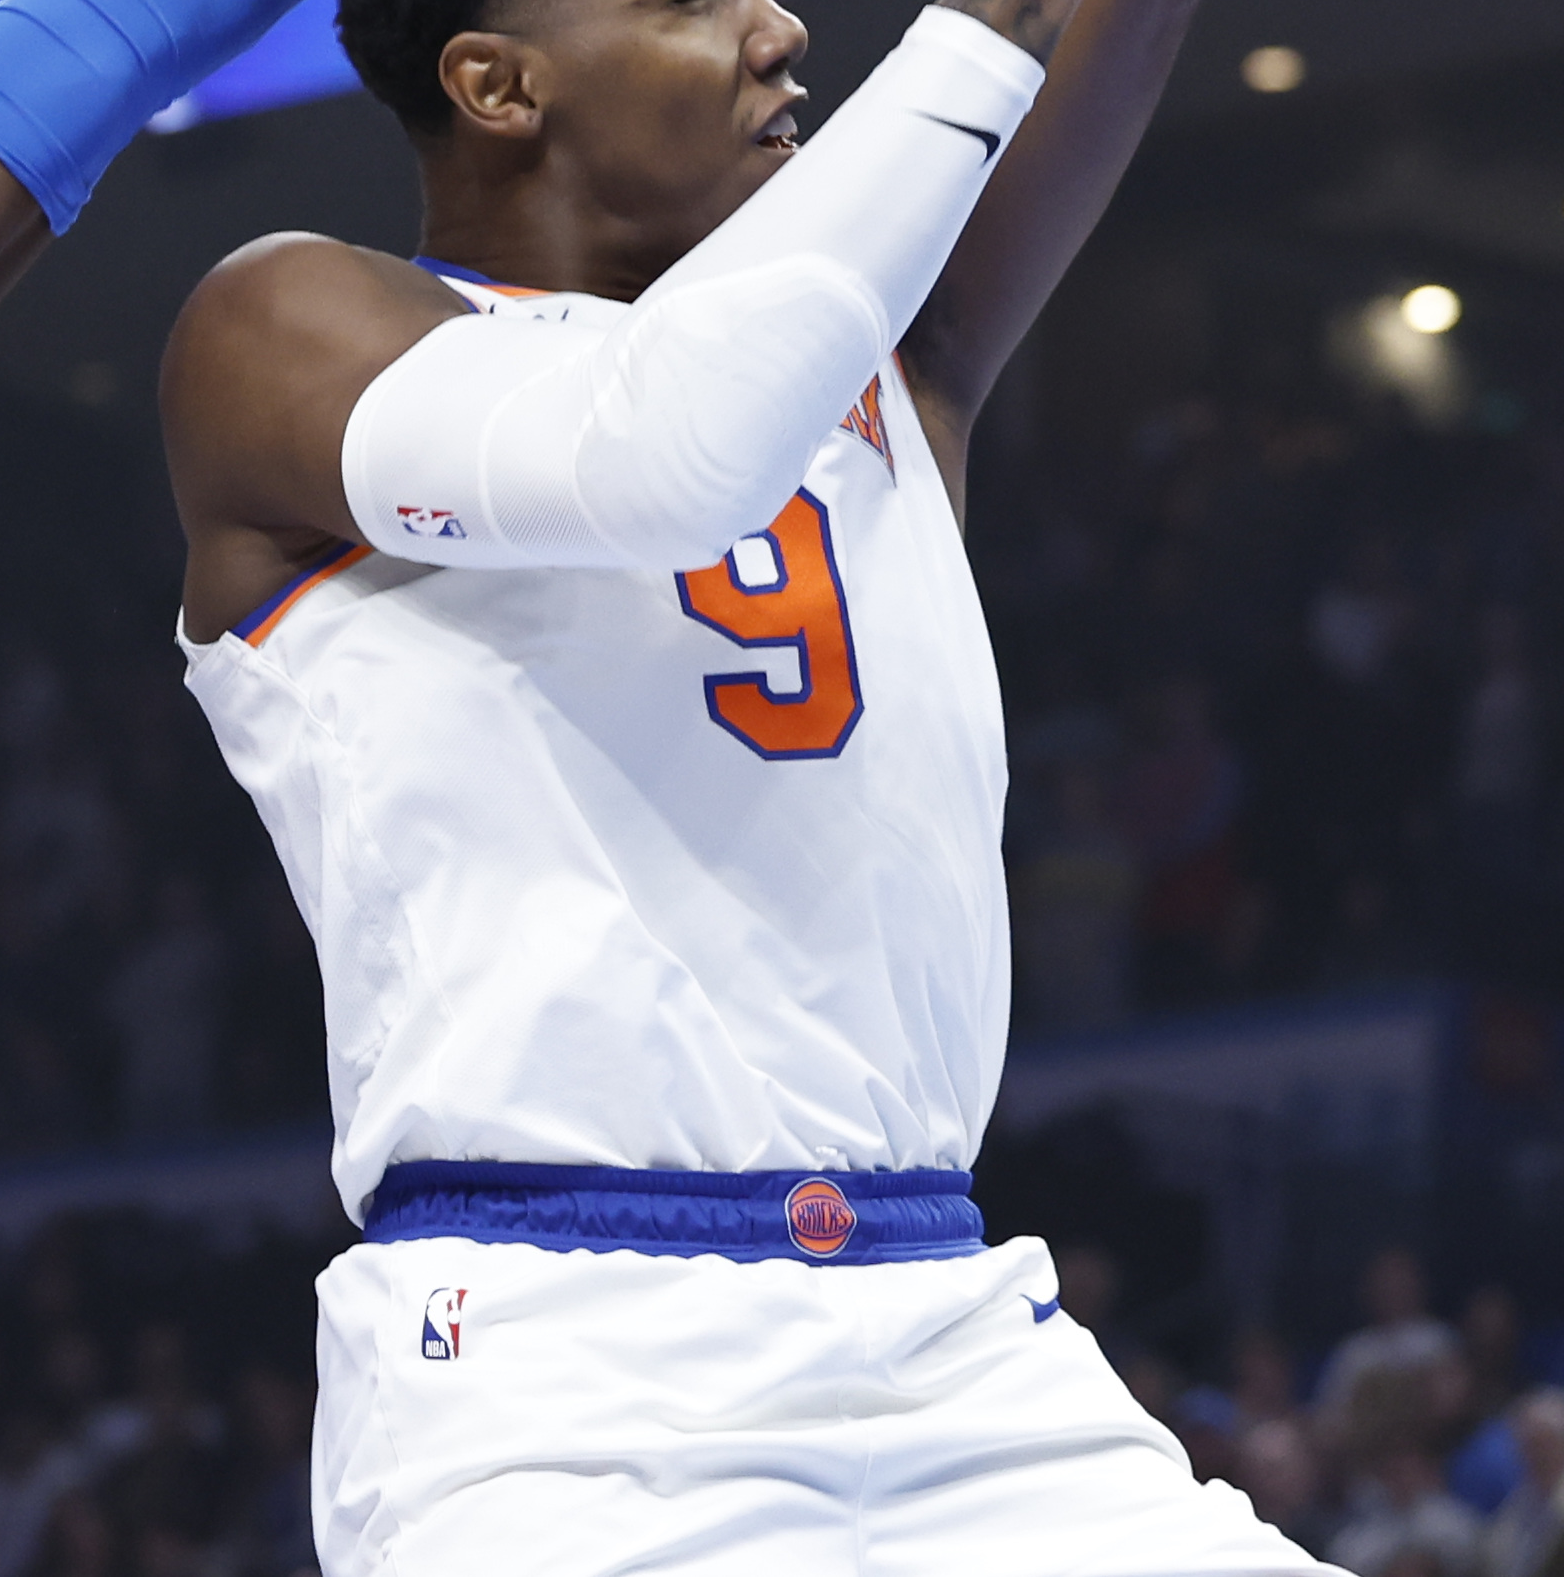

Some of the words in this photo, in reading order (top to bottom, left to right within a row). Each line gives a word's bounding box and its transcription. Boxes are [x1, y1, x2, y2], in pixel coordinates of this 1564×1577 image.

[675, 486, 865, 761] 9
[796, 1201, 848, 1235] KNICKS
[425, 1339, 446, 1358] NBA
